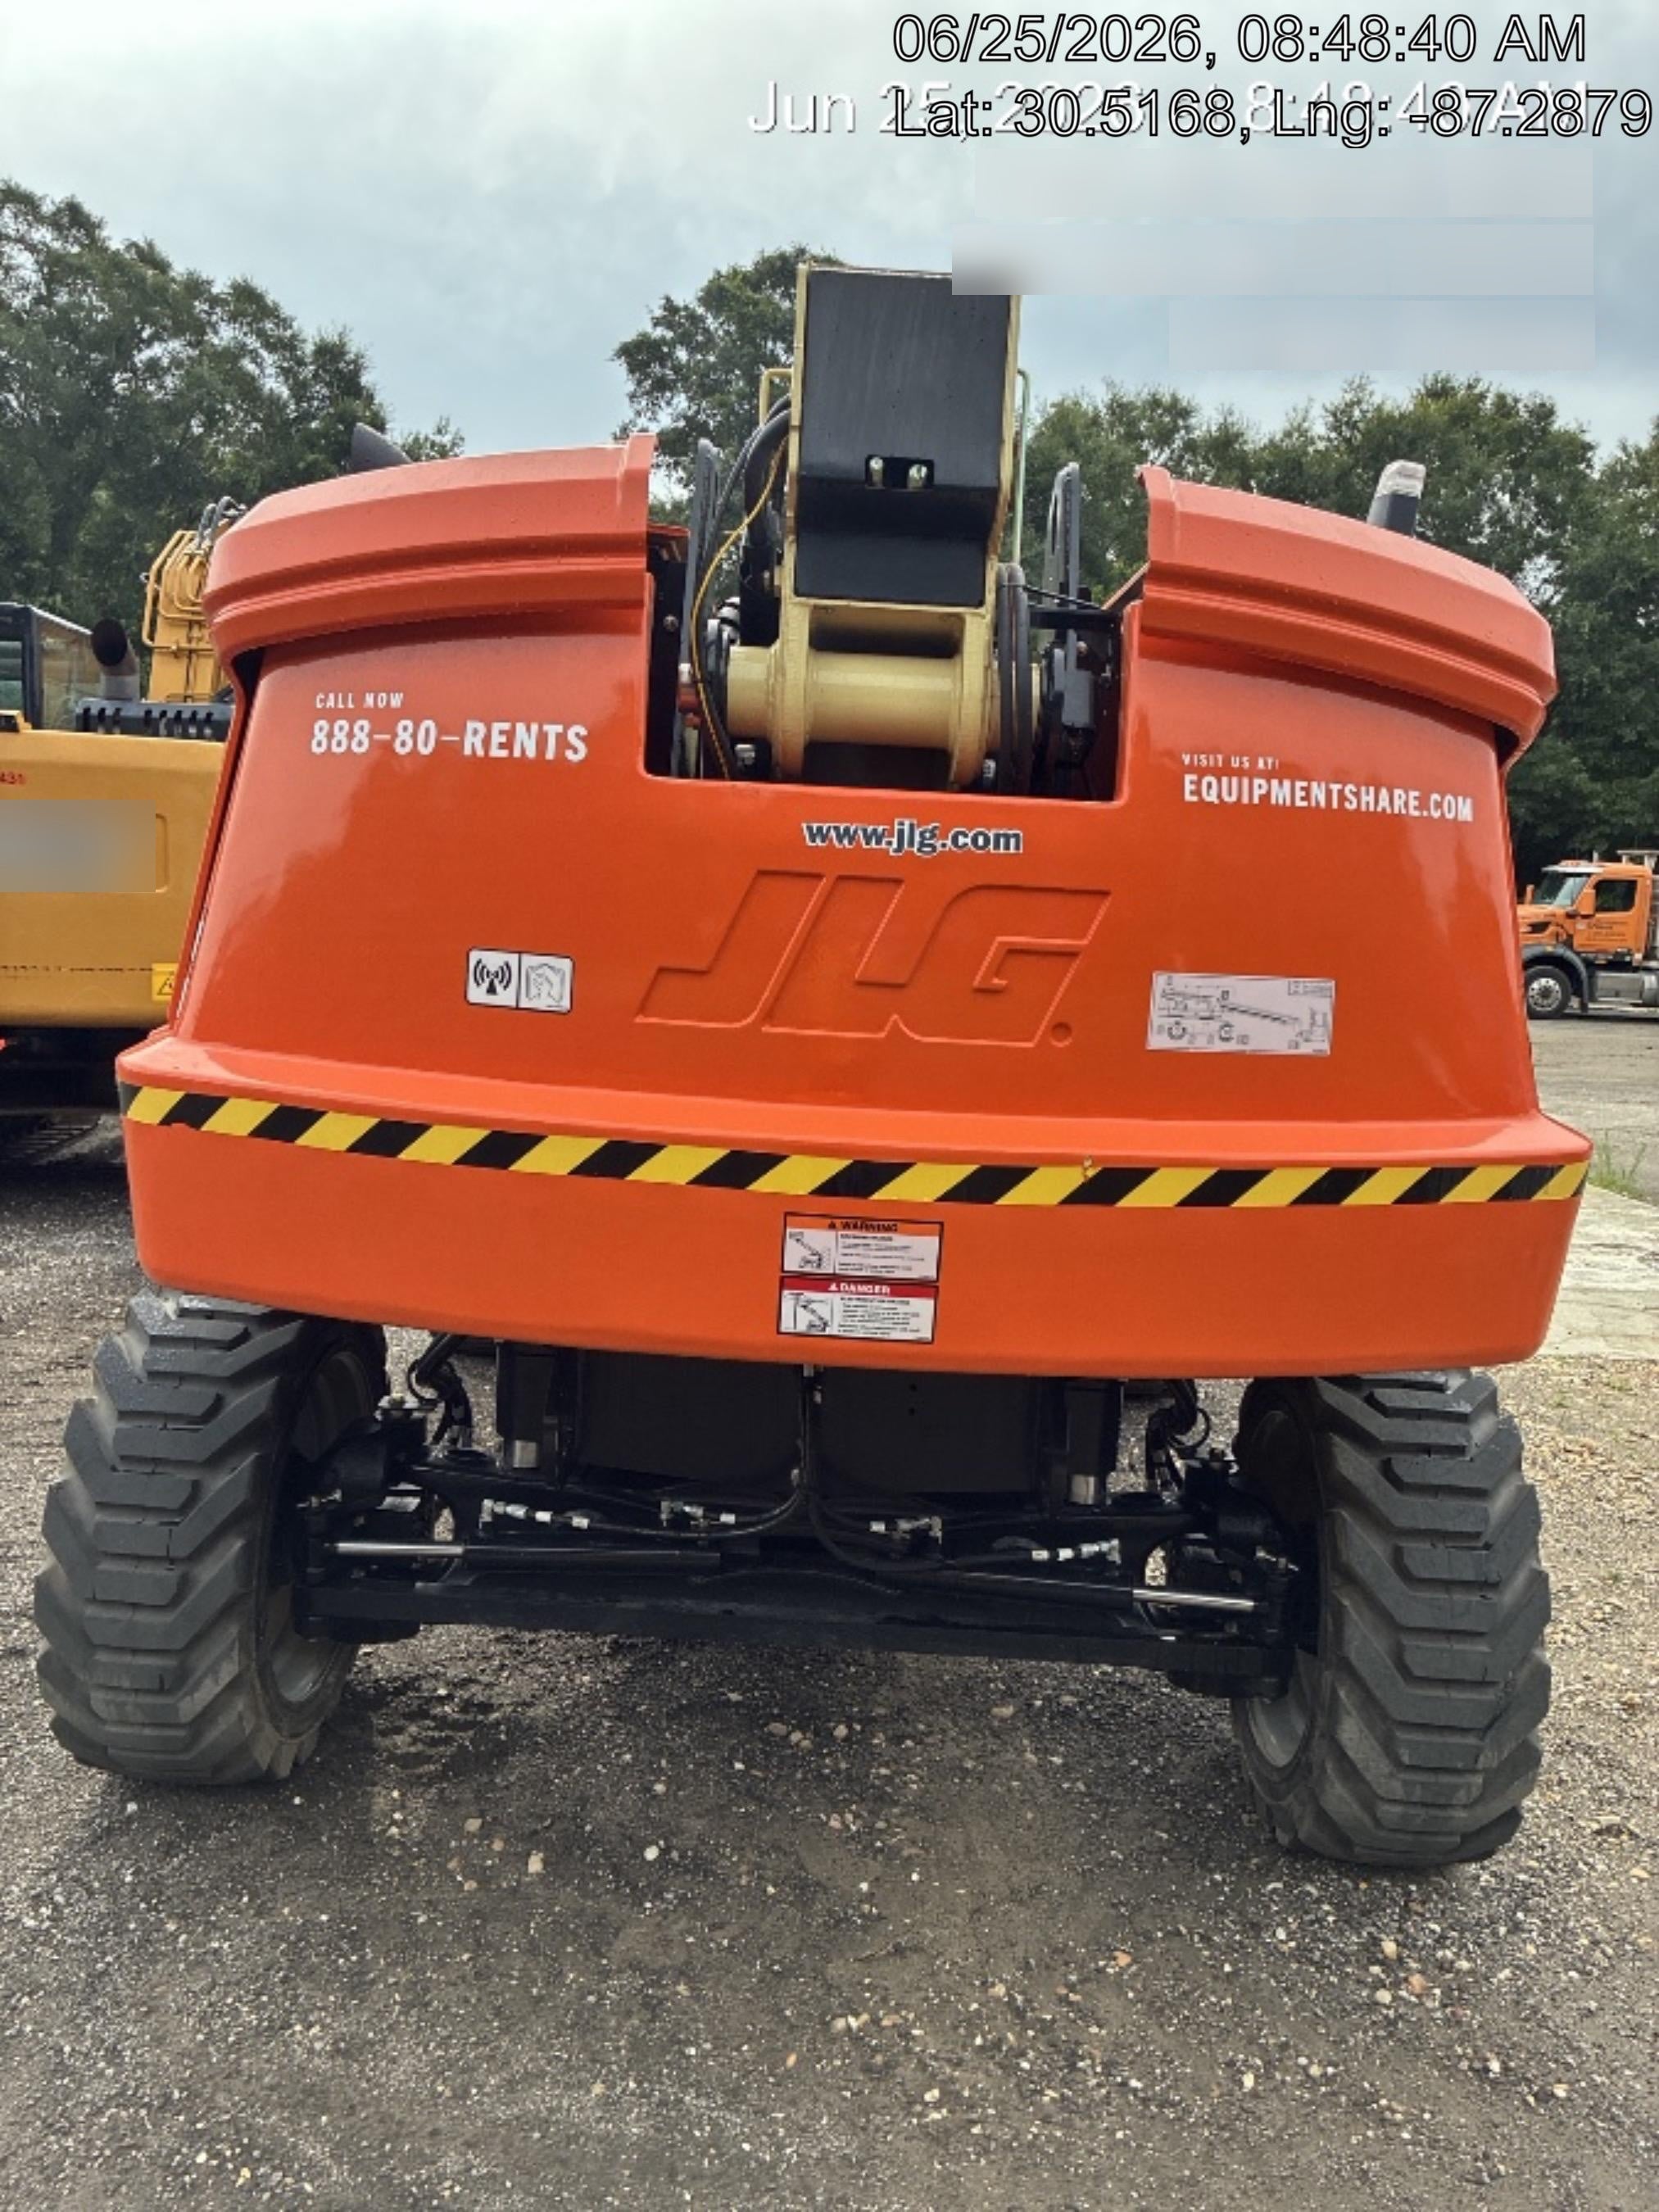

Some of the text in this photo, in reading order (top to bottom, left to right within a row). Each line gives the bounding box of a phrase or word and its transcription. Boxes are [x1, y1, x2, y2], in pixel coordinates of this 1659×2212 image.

[315, 692, 405, 709] CALL NOW
[310, 718, 589, 764] 888-80-RENTS
[1181, 752, 1223, 768] VISIT
[1231, 755, 1250, 769] US
[1183, 773, 1474, 823] EQUIPMENTSHARE.COM
[801, 819, 1023, 856] www.jlg.com
[841, 1220, 899, 1233] WARNING
[840, 1282, 891, 1294] DANGER
